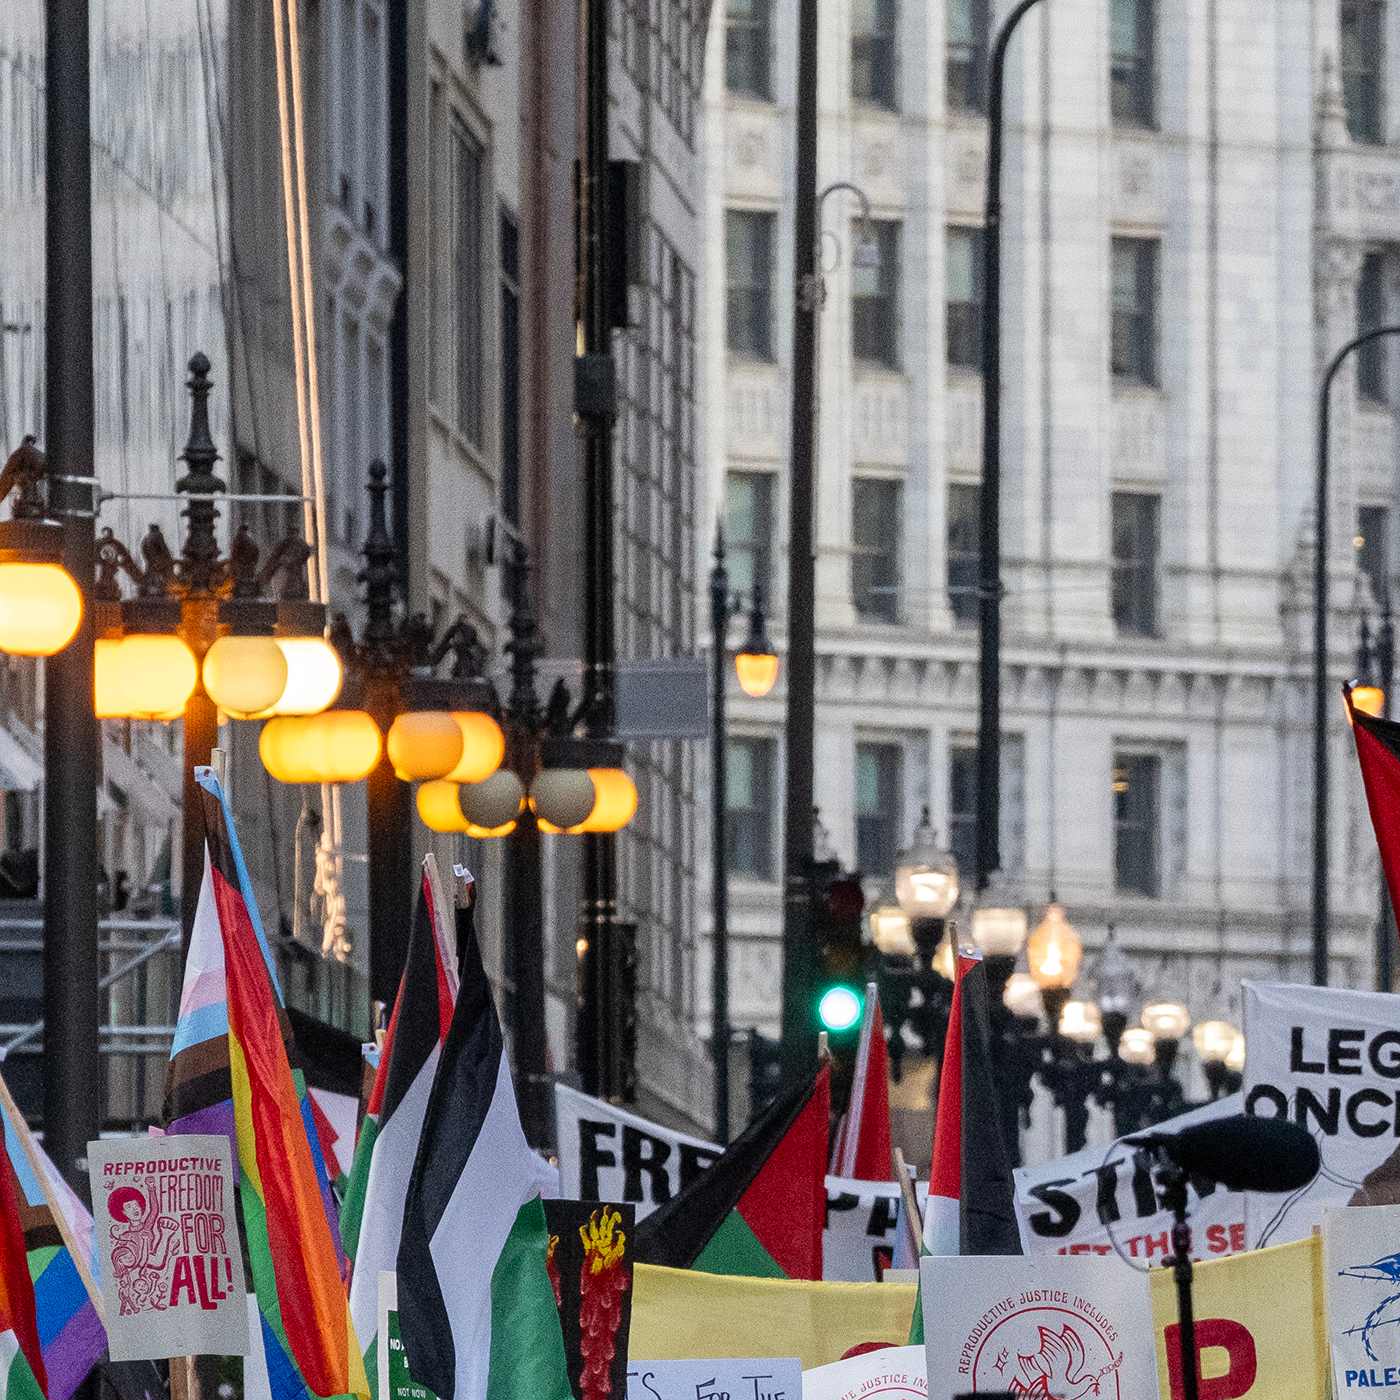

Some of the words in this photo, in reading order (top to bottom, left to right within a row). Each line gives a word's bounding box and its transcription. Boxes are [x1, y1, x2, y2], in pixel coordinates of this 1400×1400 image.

[103, 1157, 222, 1175] REPRODUCTIVE
[159, 1173, 224, 1213] FREEDOM
[180, 1213, 227, 1254] FOR
[169, 1255, 235, 1310] ALL!
[958, 1297, 1016, 1375] REPRODUCTIVE
[1019, 1289, 1068, 1305] JUSTICE
[1072, 1295, 1119, 1342] INCLUDES
[860, 1374, 908, 1393] JUSTICE
